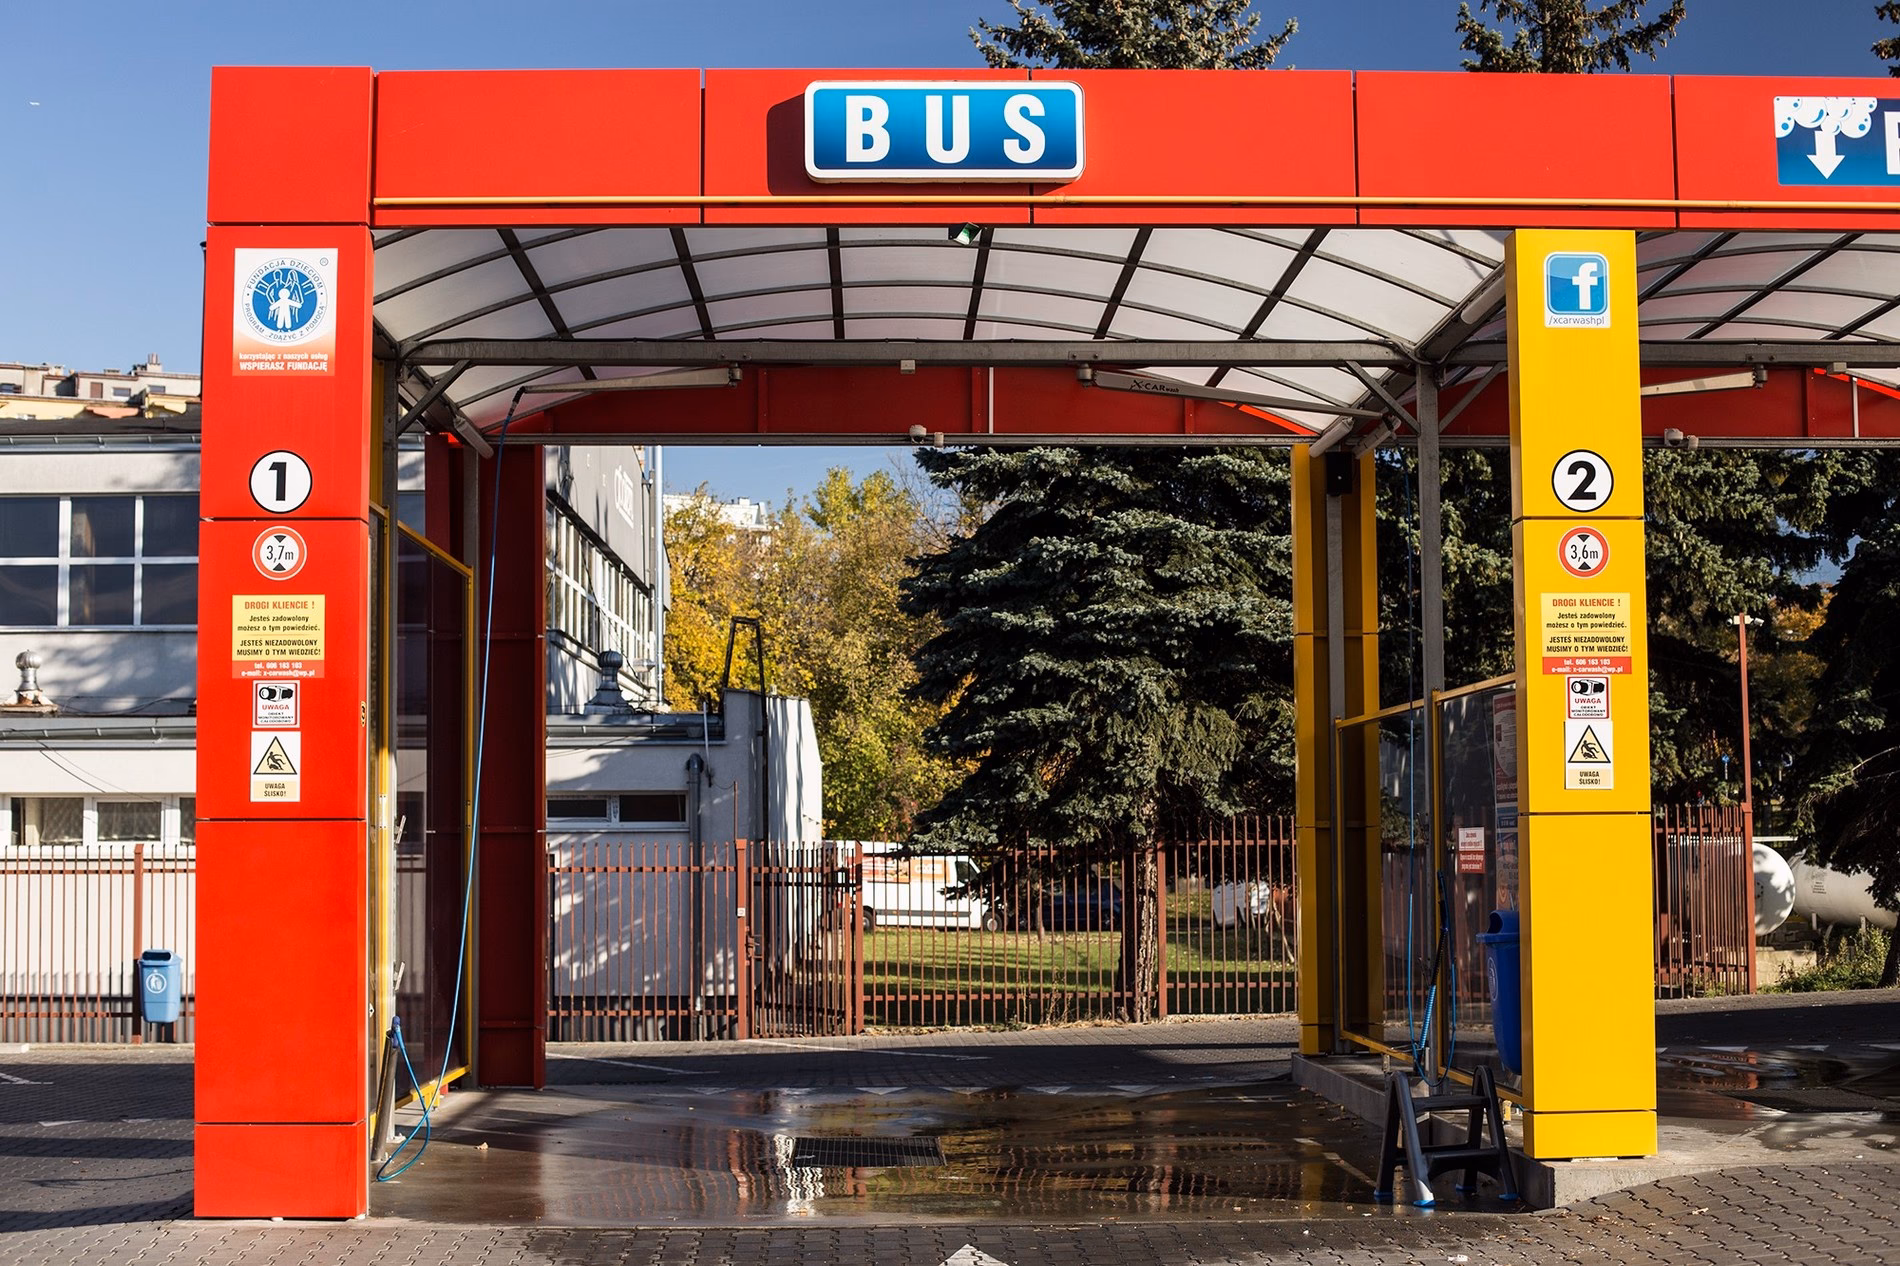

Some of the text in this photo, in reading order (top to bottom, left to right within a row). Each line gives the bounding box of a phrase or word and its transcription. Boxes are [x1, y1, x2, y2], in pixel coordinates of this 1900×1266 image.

[846, 94, 1046, 164] BUS
[247, 260, 324, 290] FUNDACJA DZIECIOM
[245, 302, 265, 334] PROGRAM
[1548, 316, 1605, 326] /xcarwashpl
[240, 362, 328, 372] WSPIERASZ FUNDACJĘ
[269, 462, 287, 501] 1
[1568, 460, 1596, 500] 2
[245, 601, 269, 609] DROGI
[272, 601, 308, 609] KLIENCIE
[1552, 599, 1577, 607] DROGI
[1580, 599, 1614, 607] KLIENCIE
[1580, 612, 1615, 620] zadowolony
